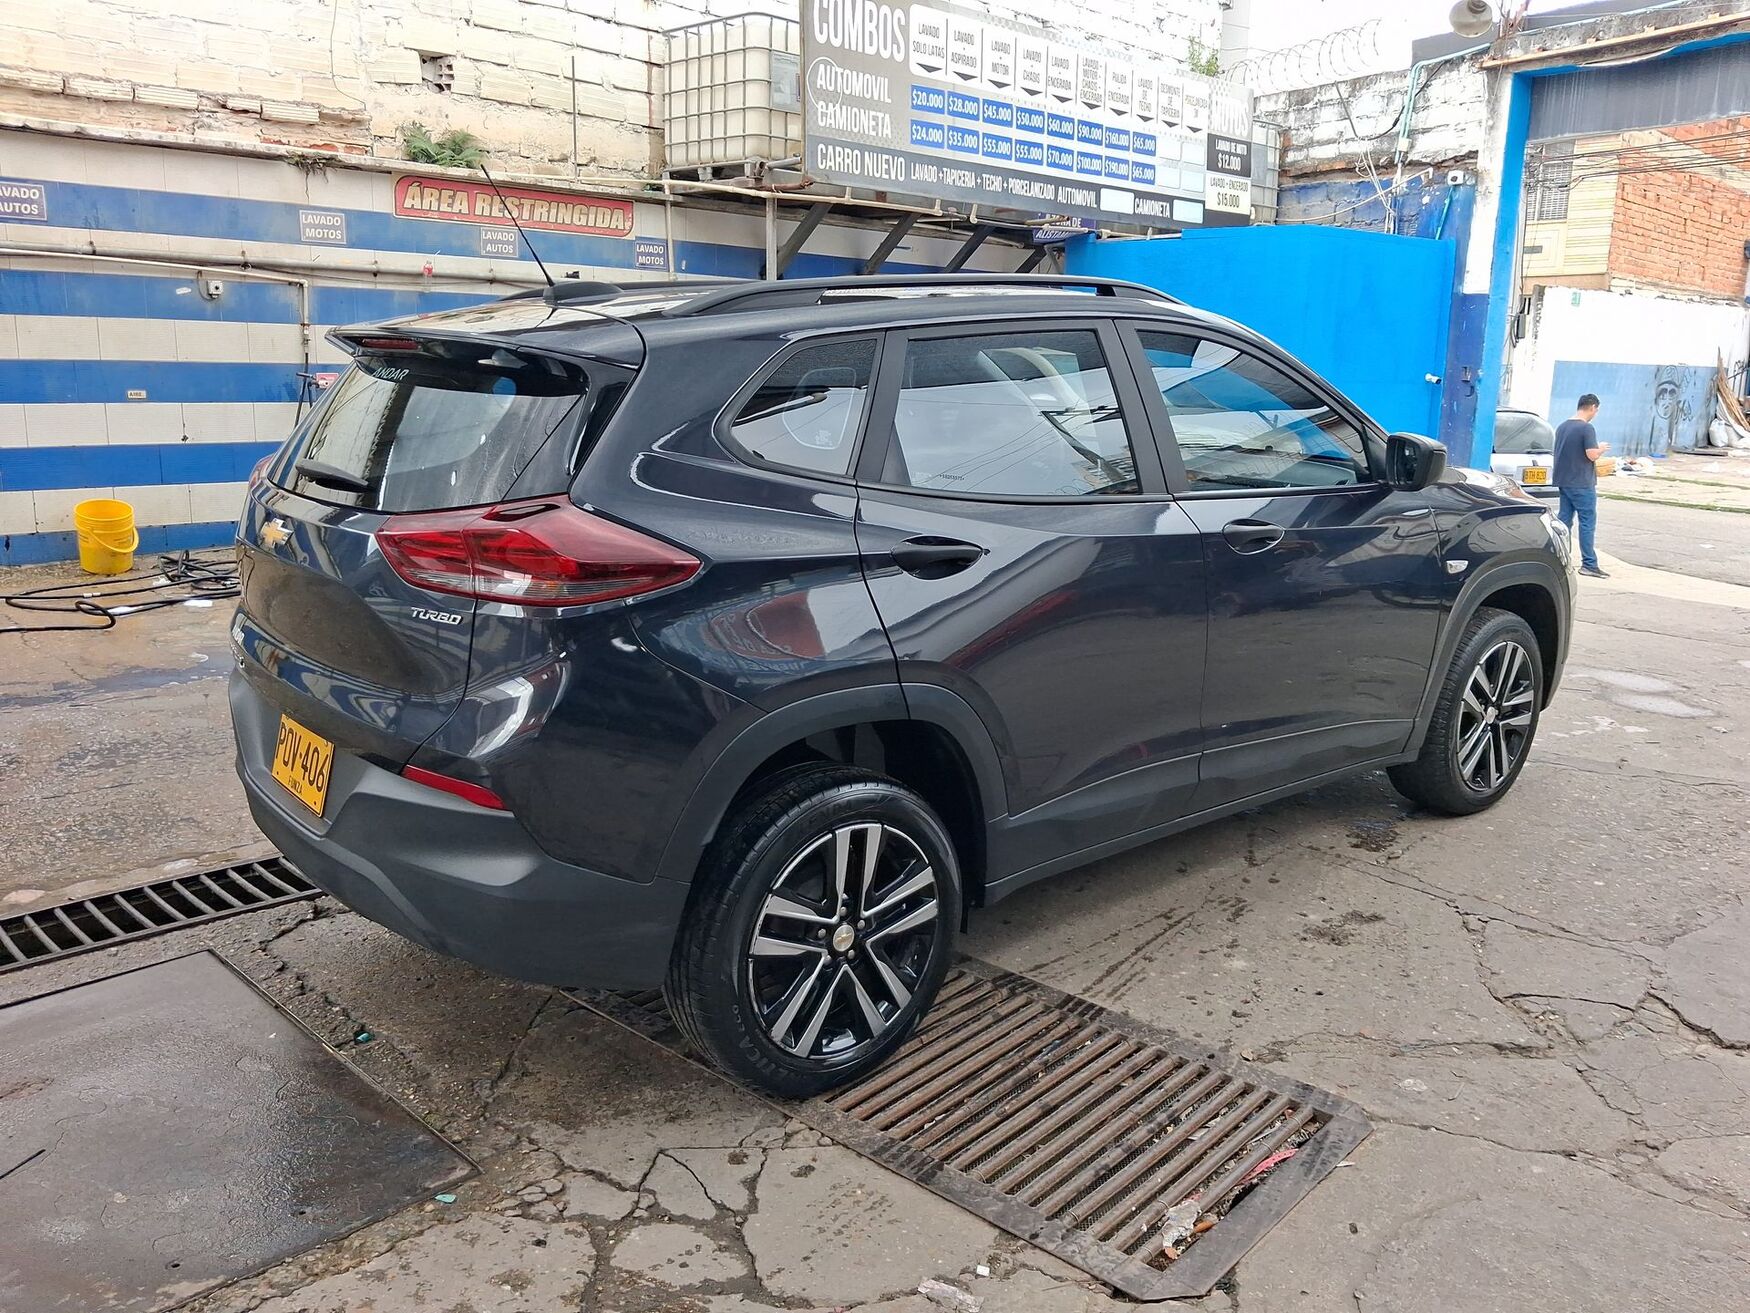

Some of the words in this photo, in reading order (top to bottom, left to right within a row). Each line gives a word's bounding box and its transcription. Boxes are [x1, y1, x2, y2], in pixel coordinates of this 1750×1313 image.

[813, 0, 906, 62] COMBOS
[918, 23, 940, 38] LAVADO
[954, 30, 974, 46] LAVADO
[912, 40, 926, 54] SOLO
[928, 44, 945, 58] LATAS
[991, 40, 1010, 55] LAVADO
[1023, 49, 1042, 63] LAVADO
[951, 52, 977, 68] ASPIRADO
[1052, 56, 1070, 70] LAVADO
[992, 62, 1010, 76] MOTOR
[817, 64, 891, 104] AUTOMOVIL
[912, 91, 944, 110] $20.000
[948, 97, 978, 116] $28.000
[818, 100, 892, 138] CAMIONETA
[984, 104, 1012, 122] $45.000
[1017, 111, 1044, 128] $50.000
[912, 124, 943, 144] $24.000
[1048, 118, 1073, 134] $60.000
[948, 130, 978, 149] $35.000
[983, 138, 1011, 156] $55.000
[1016, 142, 1042, 160] $55.000
[1048, 148, 1072, 166] $70.000
[818, 144, 860, 175] CARRO
[864, 152, 906, 182] NUEVO
[1218, 153, 1241, 171] $12.000
[911, 166, 938, 184] LAVADO
[982, 174, 1002, 192] TECHO
[1008, 178, 1055, 200] PORCELANIZADO
[1057, 186, 1097, 208] AUTOMOVIL
[1134, 198, 1170, 218] CAMIONETA
[1217, 192, 1239, 208] $15.000
[404, 180, 470, 214] ÁREA
[475, 192, 626, 230] RESTRINGIDA
[302, 214, 340, 226] LAVADO
[1072, 217, 1081, 228] DE
[306, 228, 342, 240] MOTOS
[482, 231, 514, 242] LAVADO
[486, 244, 514, 254] AUTOS
[636, 244, 664, 254] LAVADO
[638, 255, 664, 265] MOTOS
[411, 606, 462, 625] TURBO
